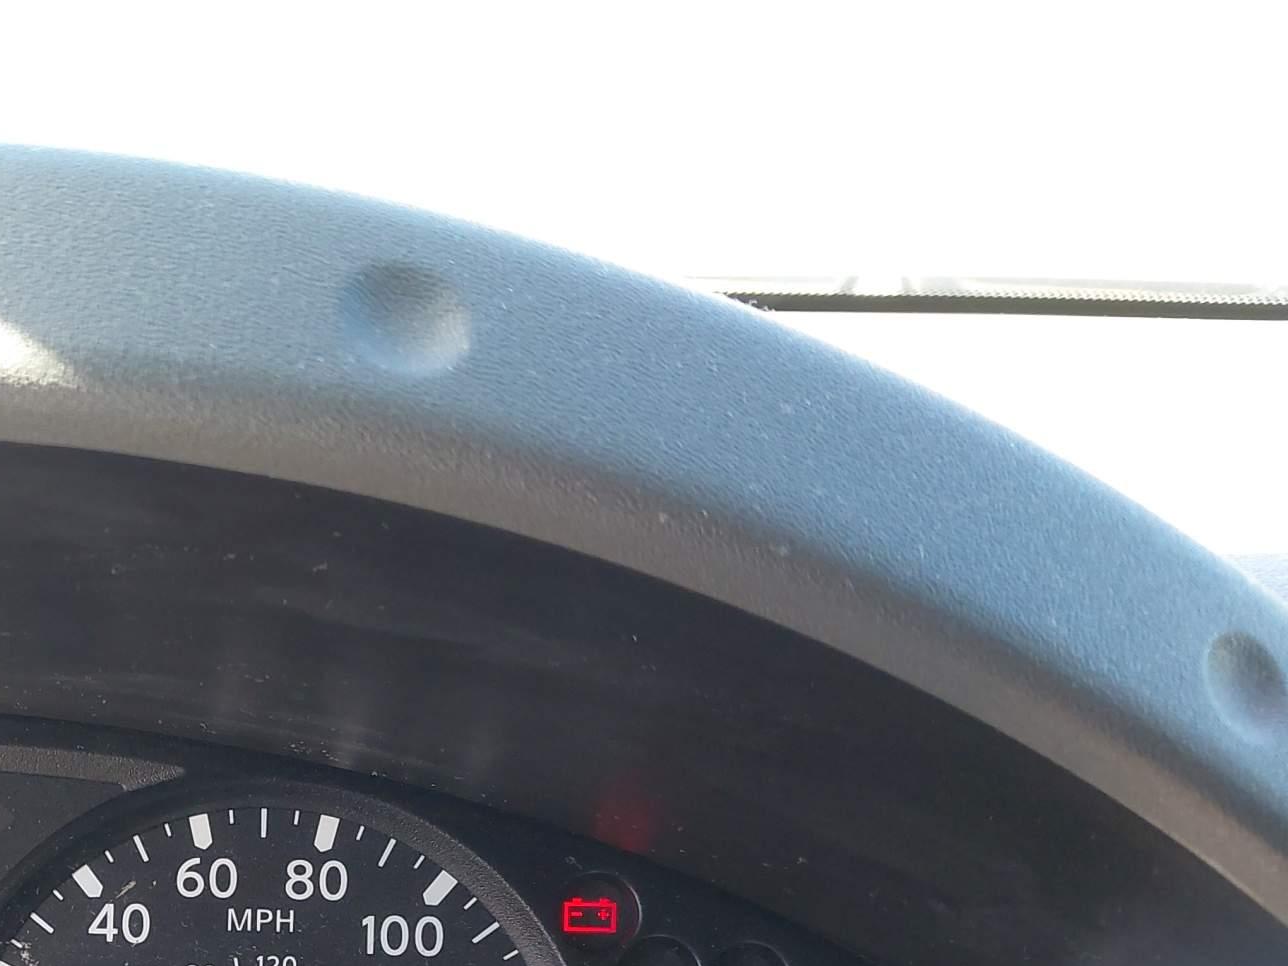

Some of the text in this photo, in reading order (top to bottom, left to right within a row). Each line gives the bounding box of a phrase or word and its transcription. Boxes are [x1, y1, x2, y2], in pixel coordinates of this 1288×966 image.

[176, 857, 238, 899] 60
[285, 859, 348, 901] 80
[88, 903, 150, 945] 40
[227, 908, 294, 933] MPH
[362, 915, 444, 957] 100
